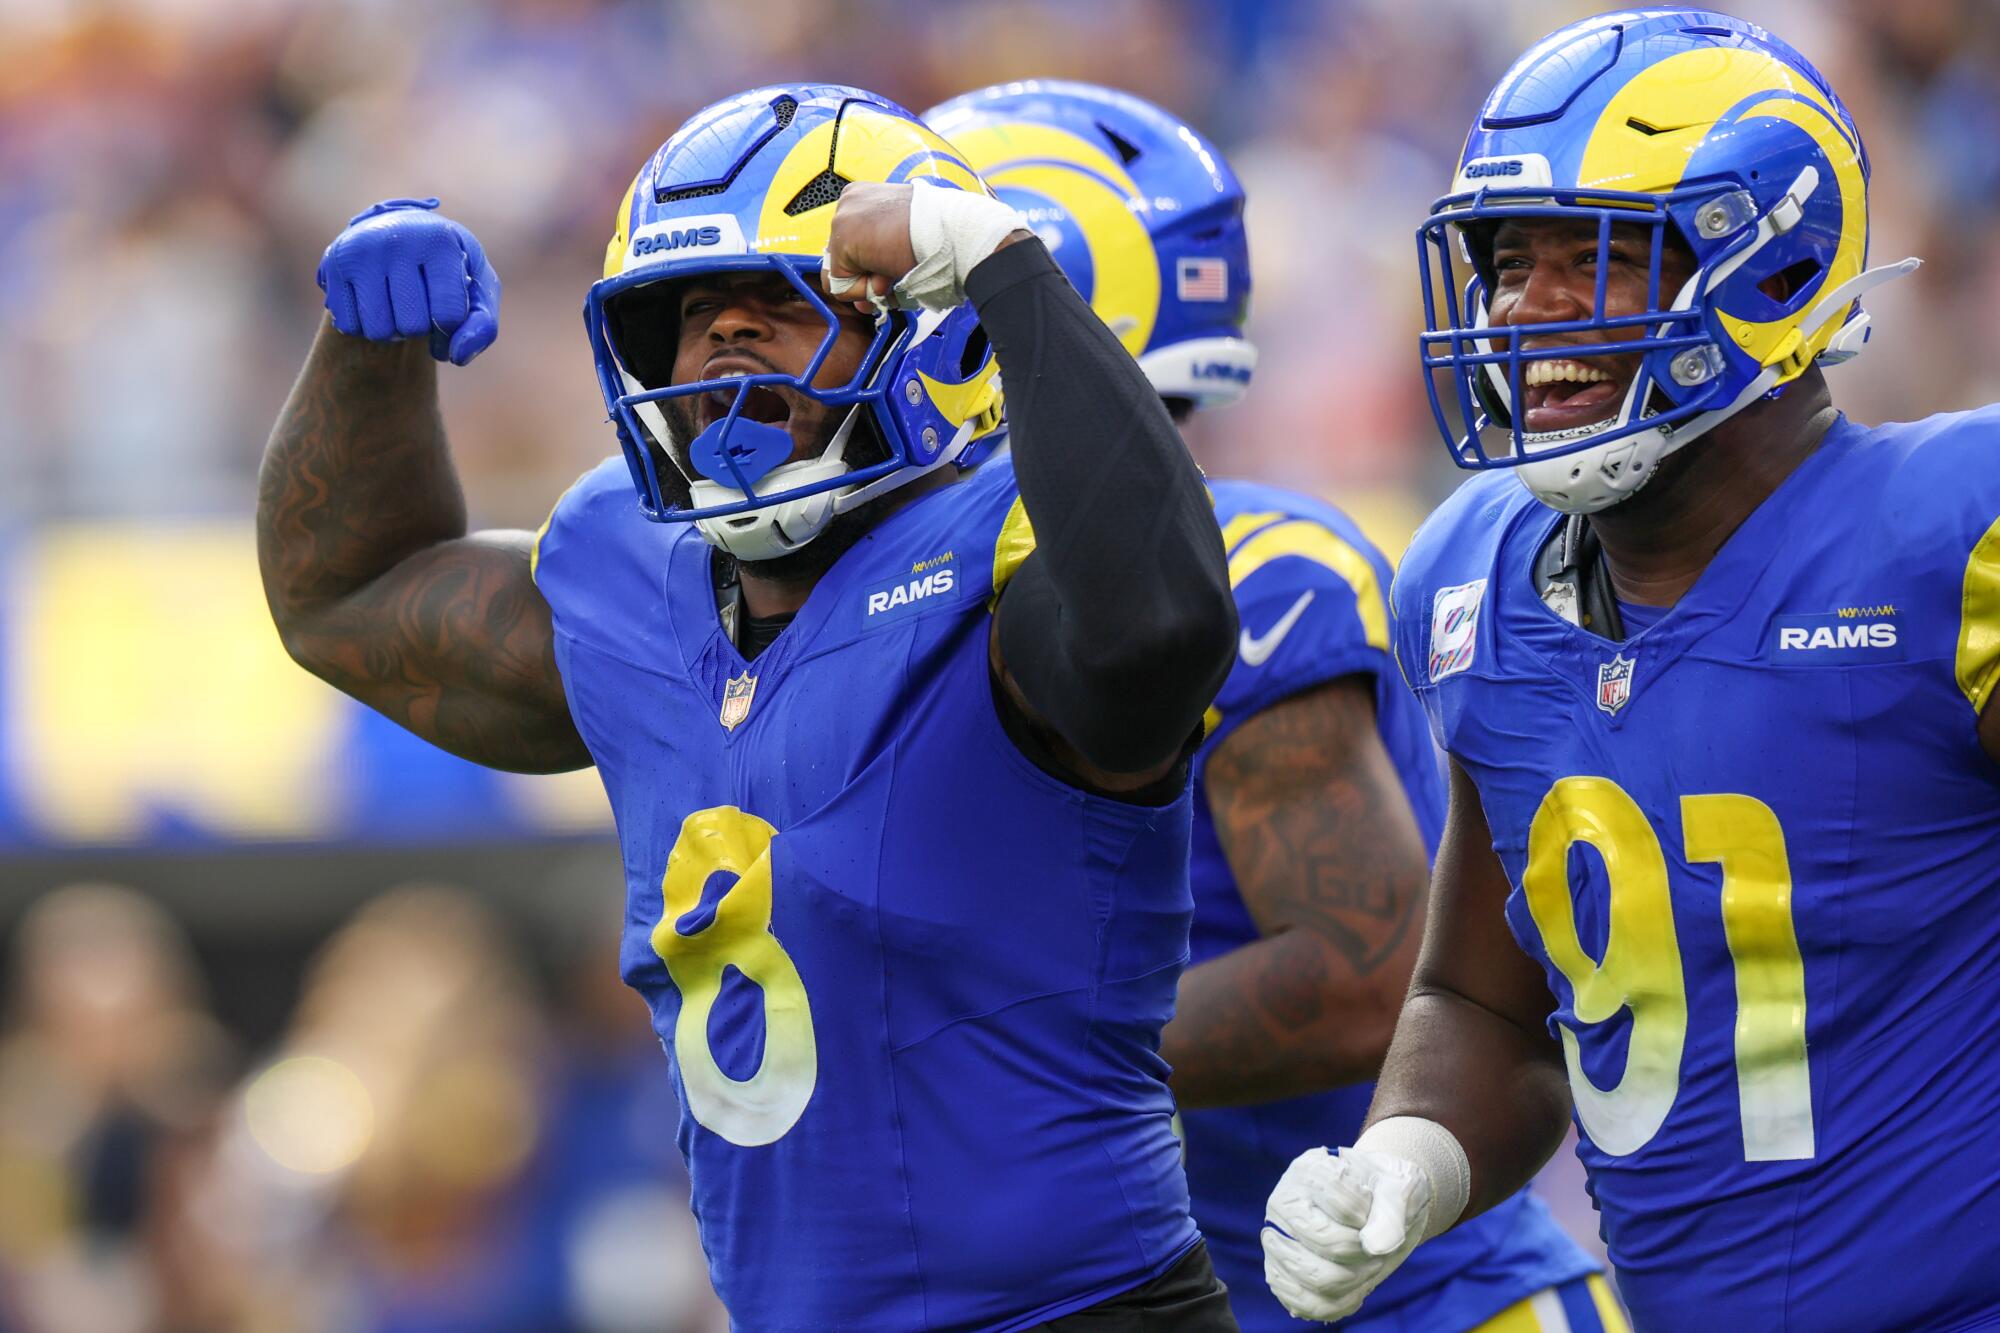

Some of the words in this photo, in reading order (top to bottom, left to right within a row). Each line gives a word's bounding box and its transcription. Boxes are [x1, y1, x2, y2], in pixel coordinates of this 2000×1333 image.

[1465, 160, 1522, 179] RAMS
[633, 226, 721, 257] RAMS
[868, 569, 954, 616] RAMS
[1779, 623, 1897, 650] RAMS
[1602, 681, 1626, 704] NFL
[652, 805, 817, 1147] 8
[1523, 776, 1815, 1162] 91
